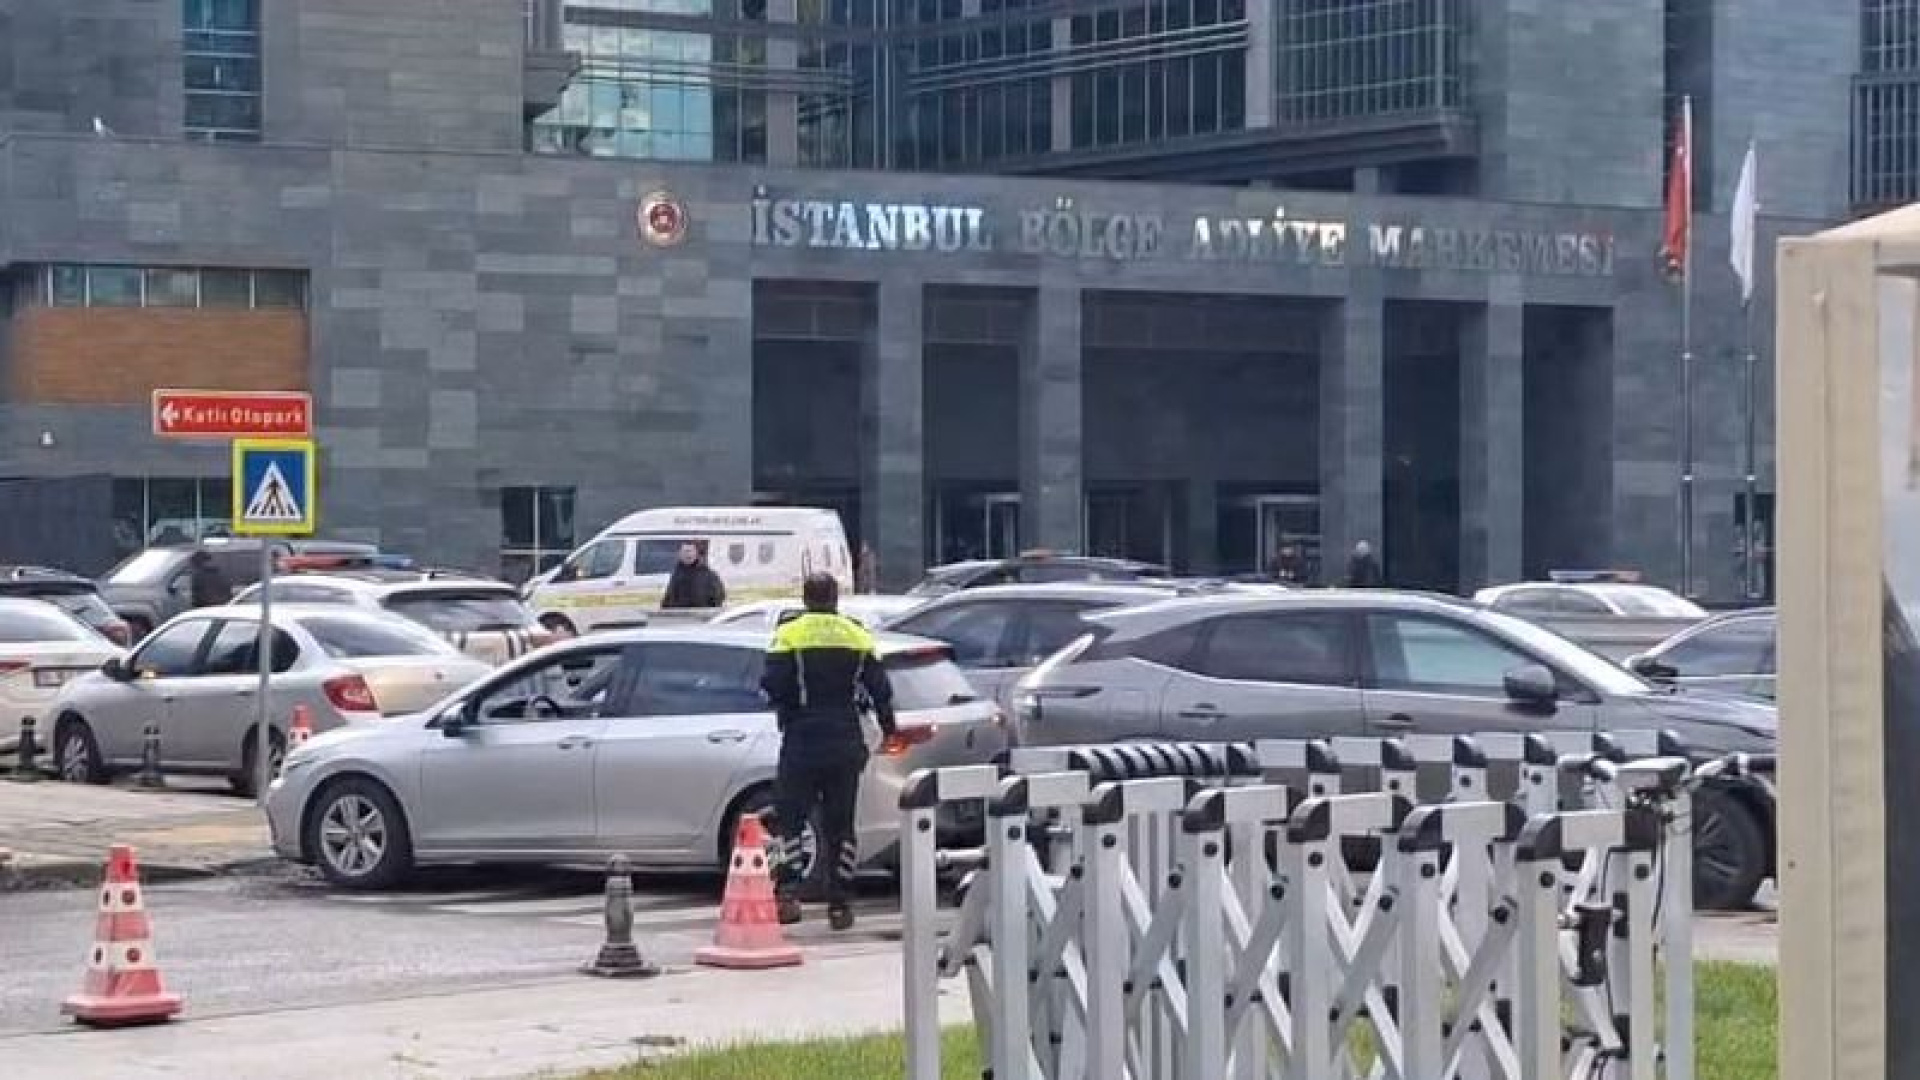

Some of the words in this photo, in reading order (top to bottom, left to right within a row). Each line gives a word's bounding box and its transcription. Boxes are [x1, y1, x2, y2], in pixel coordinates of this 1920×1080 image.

[751, 185, 993, 252] İSTANBUL
[1018, 196, 1164, 260] BÖLGE
[1189, 205, 1346, 267] ADLİYE
[229, 405, 304, 428] Otopark
